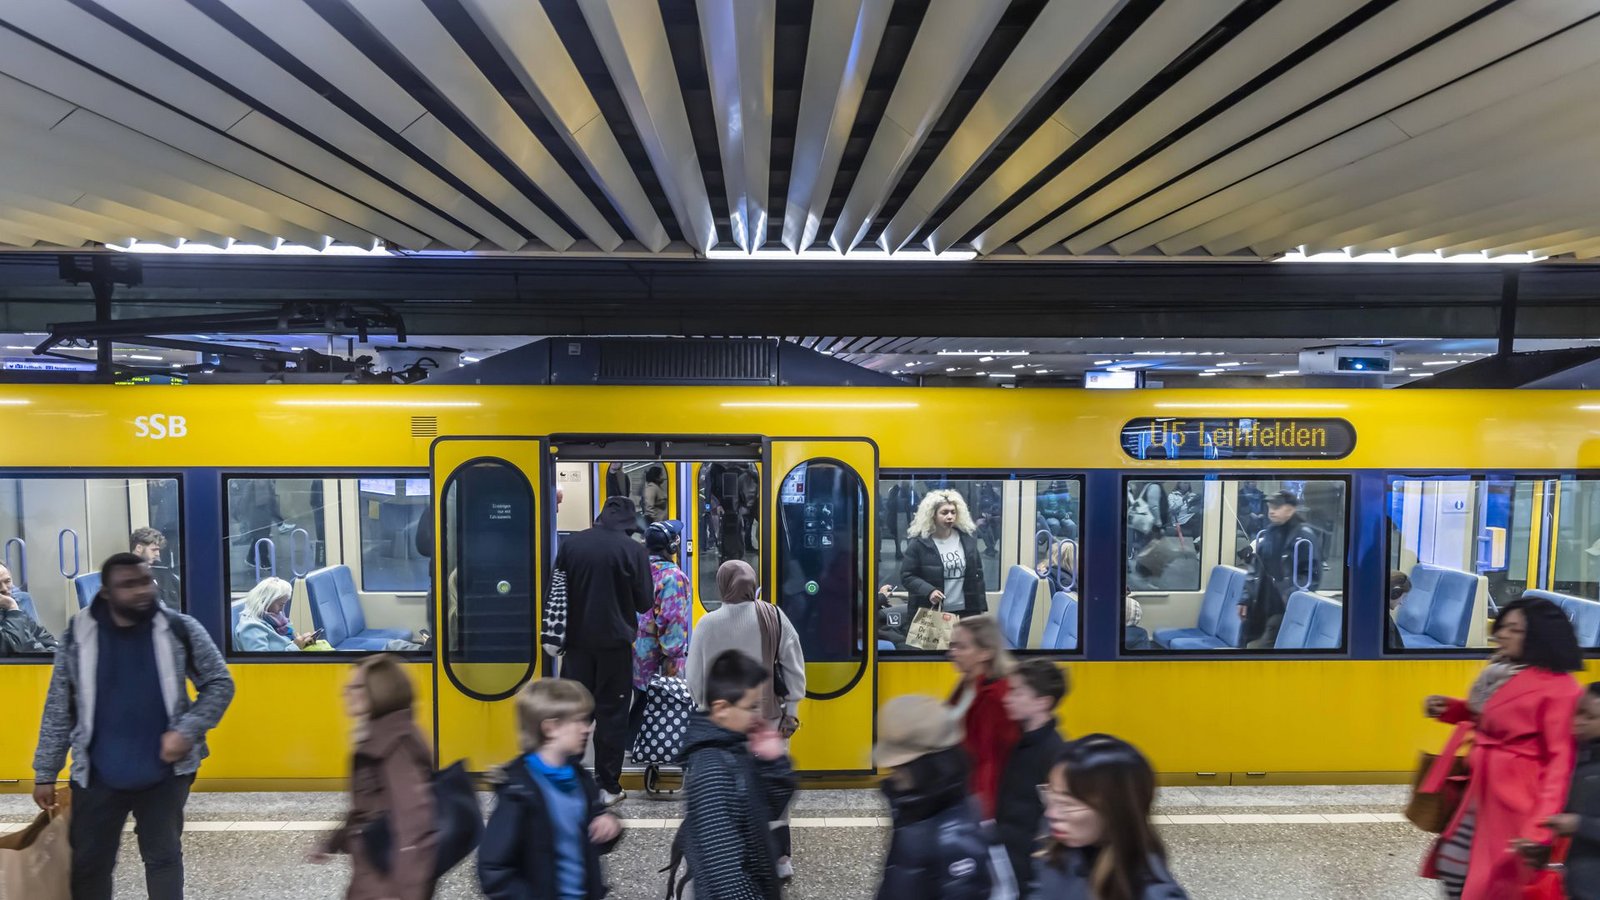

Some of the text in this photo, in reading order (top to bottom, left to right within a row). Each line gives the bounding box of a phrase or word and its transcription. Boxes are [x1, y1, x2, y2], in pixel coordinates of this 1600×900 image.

[135, 413, 187, 440] SSB
[1150, 421, 1326, 447] U5 Leinfelden
[940, 550, 961, 563] LOS
